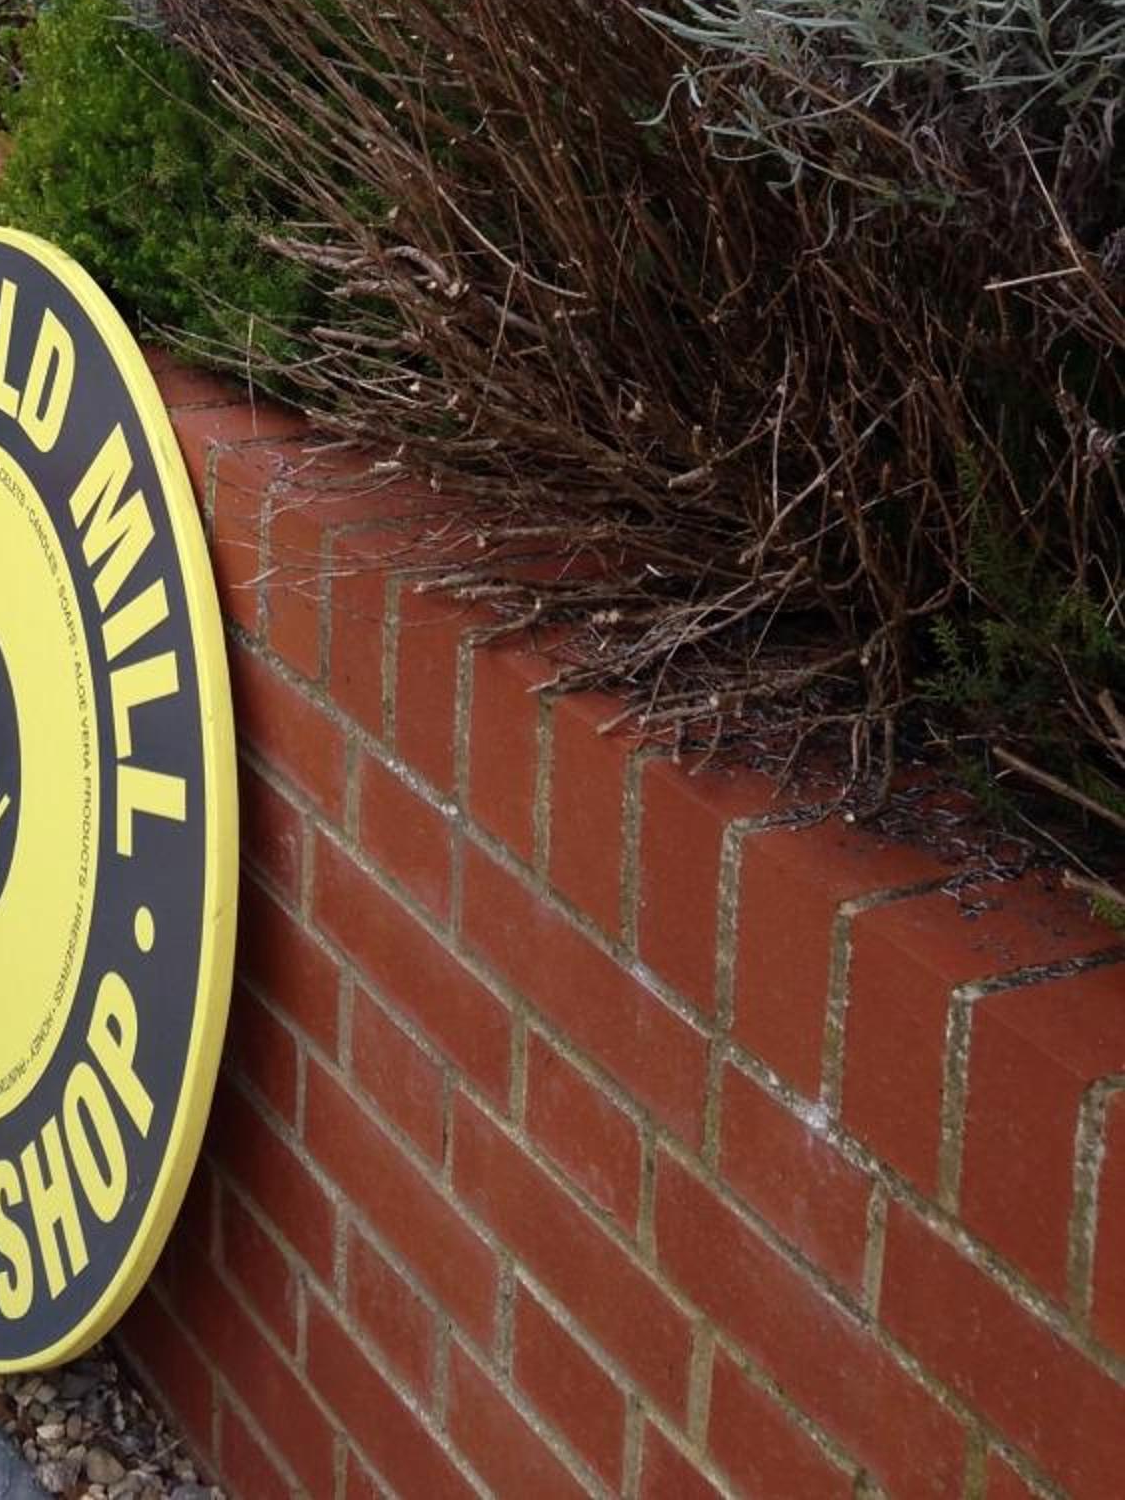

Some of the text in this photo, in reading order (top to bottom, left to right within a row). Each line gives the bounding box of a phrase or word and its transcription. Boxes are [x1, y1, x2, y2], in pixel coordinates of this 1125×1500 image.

[28, 508, 58, 576] CANDLES
[58, 584, 77, 646] SOAPS
[68, 422, 187, 858] MILL
[74, 661, 92, 888] ALOE VERA PRODUCTS
